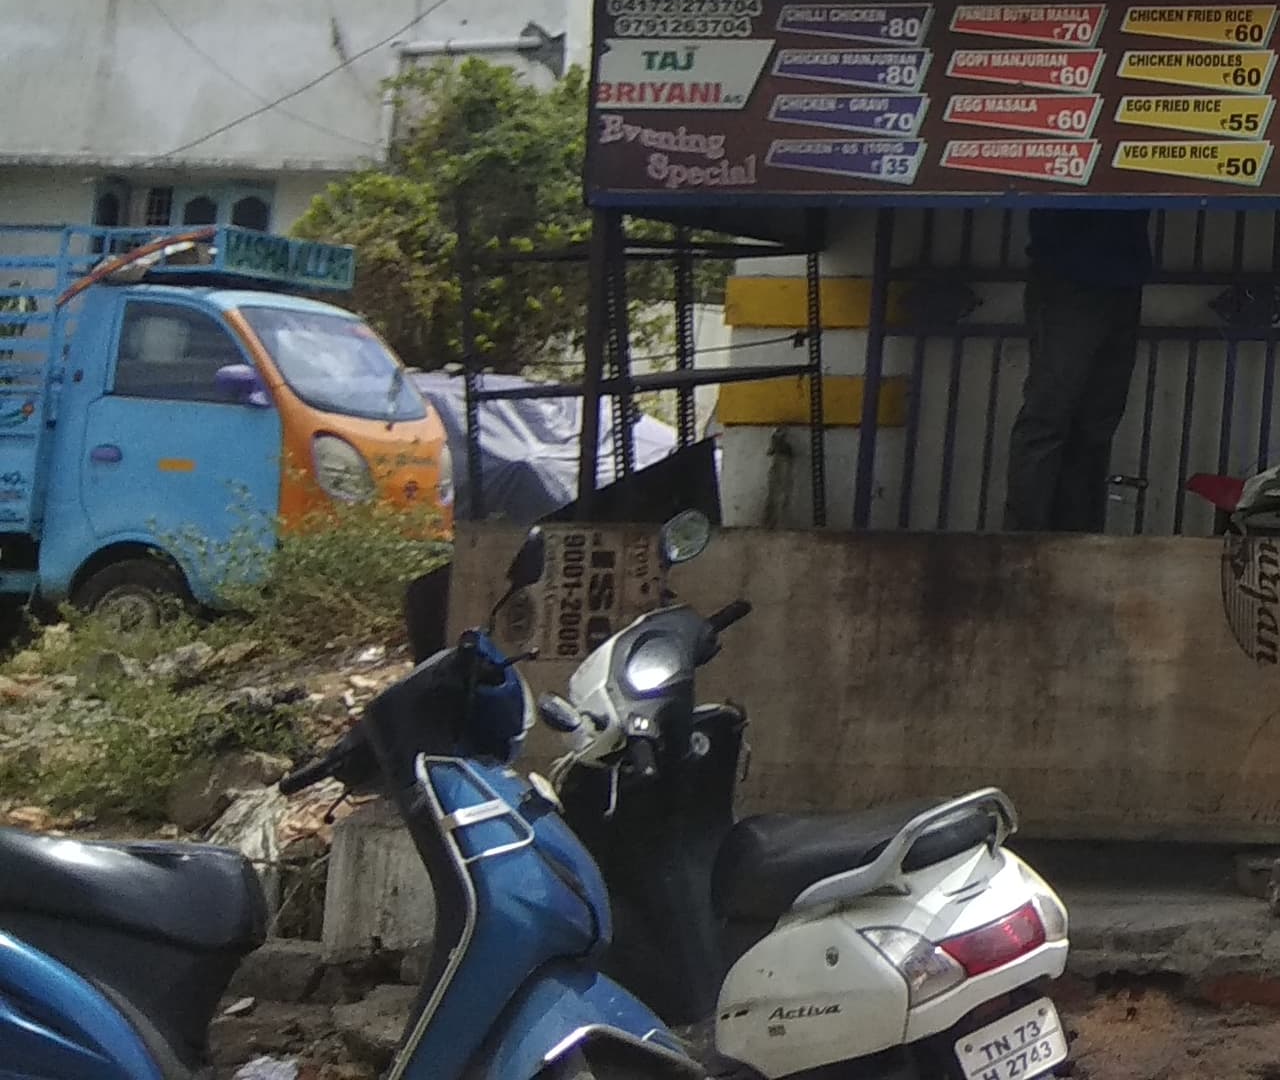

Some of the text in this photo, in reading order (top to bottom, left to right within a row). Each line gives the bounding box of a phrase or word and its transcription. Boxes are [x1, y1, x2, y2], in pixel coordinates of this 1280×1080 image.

[1129, 9, 1254, 22] CHICKEN FRIED RICE
[641, 50, 696, 71] TAJ
[991, 54, 1068, 68] MANJURIAN
[1128, 54, 1242, 67] CHICKEN NOODLES
[597, 82, 722, 104] BRIYANI
[954, 99, 1038, 112] EGG MASALA
[1126, 99, 1222, 113] EGG FRIED RICE
[599, 114, 727, 160] Evening
[951, 144, 977, 157] EGG
[1025, 144, 1079, 158] MASALA
[1123, 145, 1218, 159] VEG FRIED RICE
[647, 152, 758, 189] Special
[768, 1004, 842, 1021] Activa
[979, 1020, 1042, 1061] TN 73
[1005, 1040, 1053, 1078] 2743
